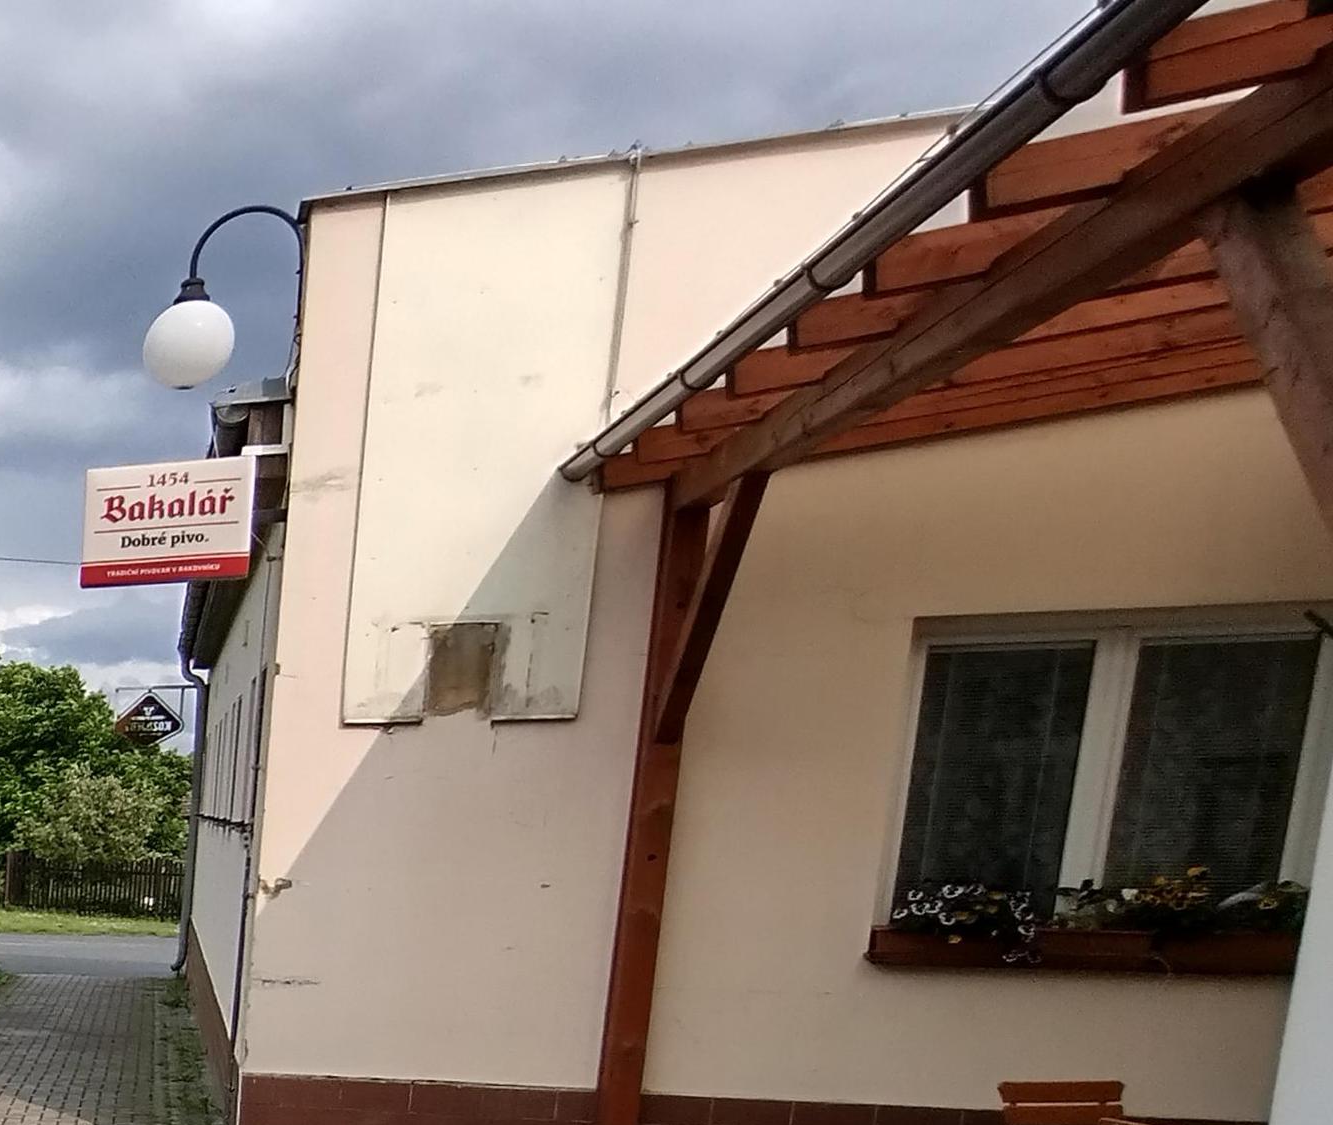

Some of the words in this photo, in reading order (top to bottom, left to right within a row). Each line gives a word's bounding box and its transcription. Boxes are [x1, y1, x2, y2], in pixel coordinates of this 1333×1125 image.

[148, 471, 189, 487] 1454
[101, 488, 235, 523] Bakalář
[121, 531, 166, 549] Dobré
[171, 531, 209, 549] pivo.
